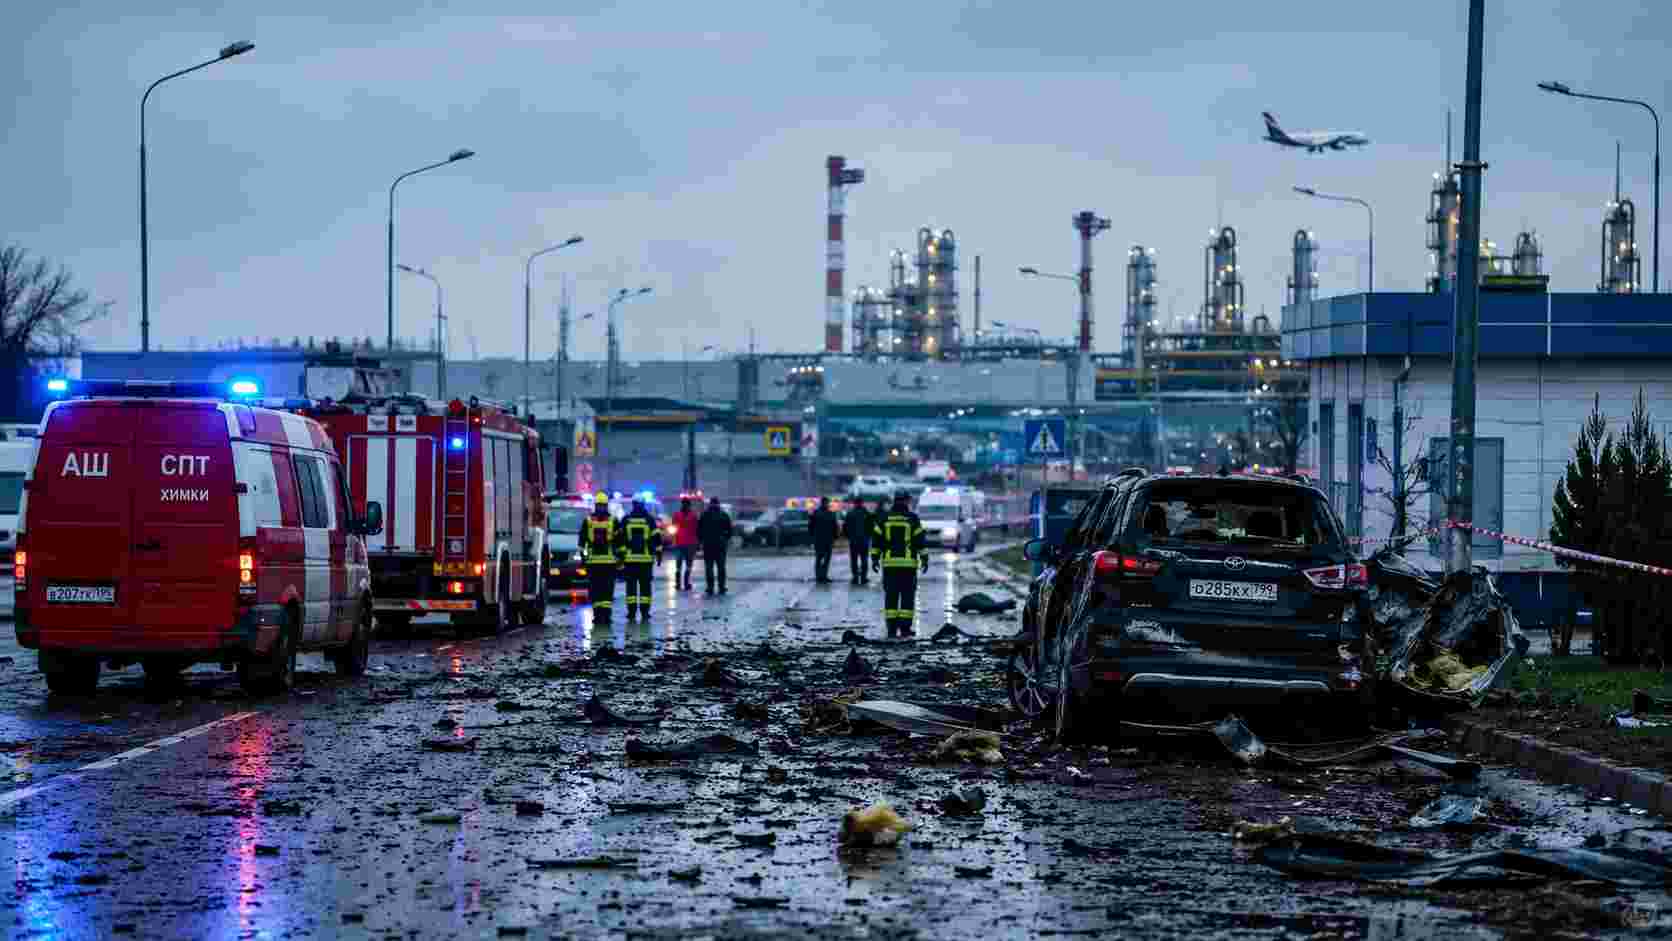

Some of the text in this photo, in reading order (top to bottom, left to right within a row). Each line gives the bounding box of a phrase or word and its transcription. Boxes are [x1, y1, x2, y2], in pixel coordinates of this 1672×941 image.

[60, 452, 109, 477] АШ
[161, 454, 210, 476] СПТ
[160, 488, 209, 501] ХИМКИ
